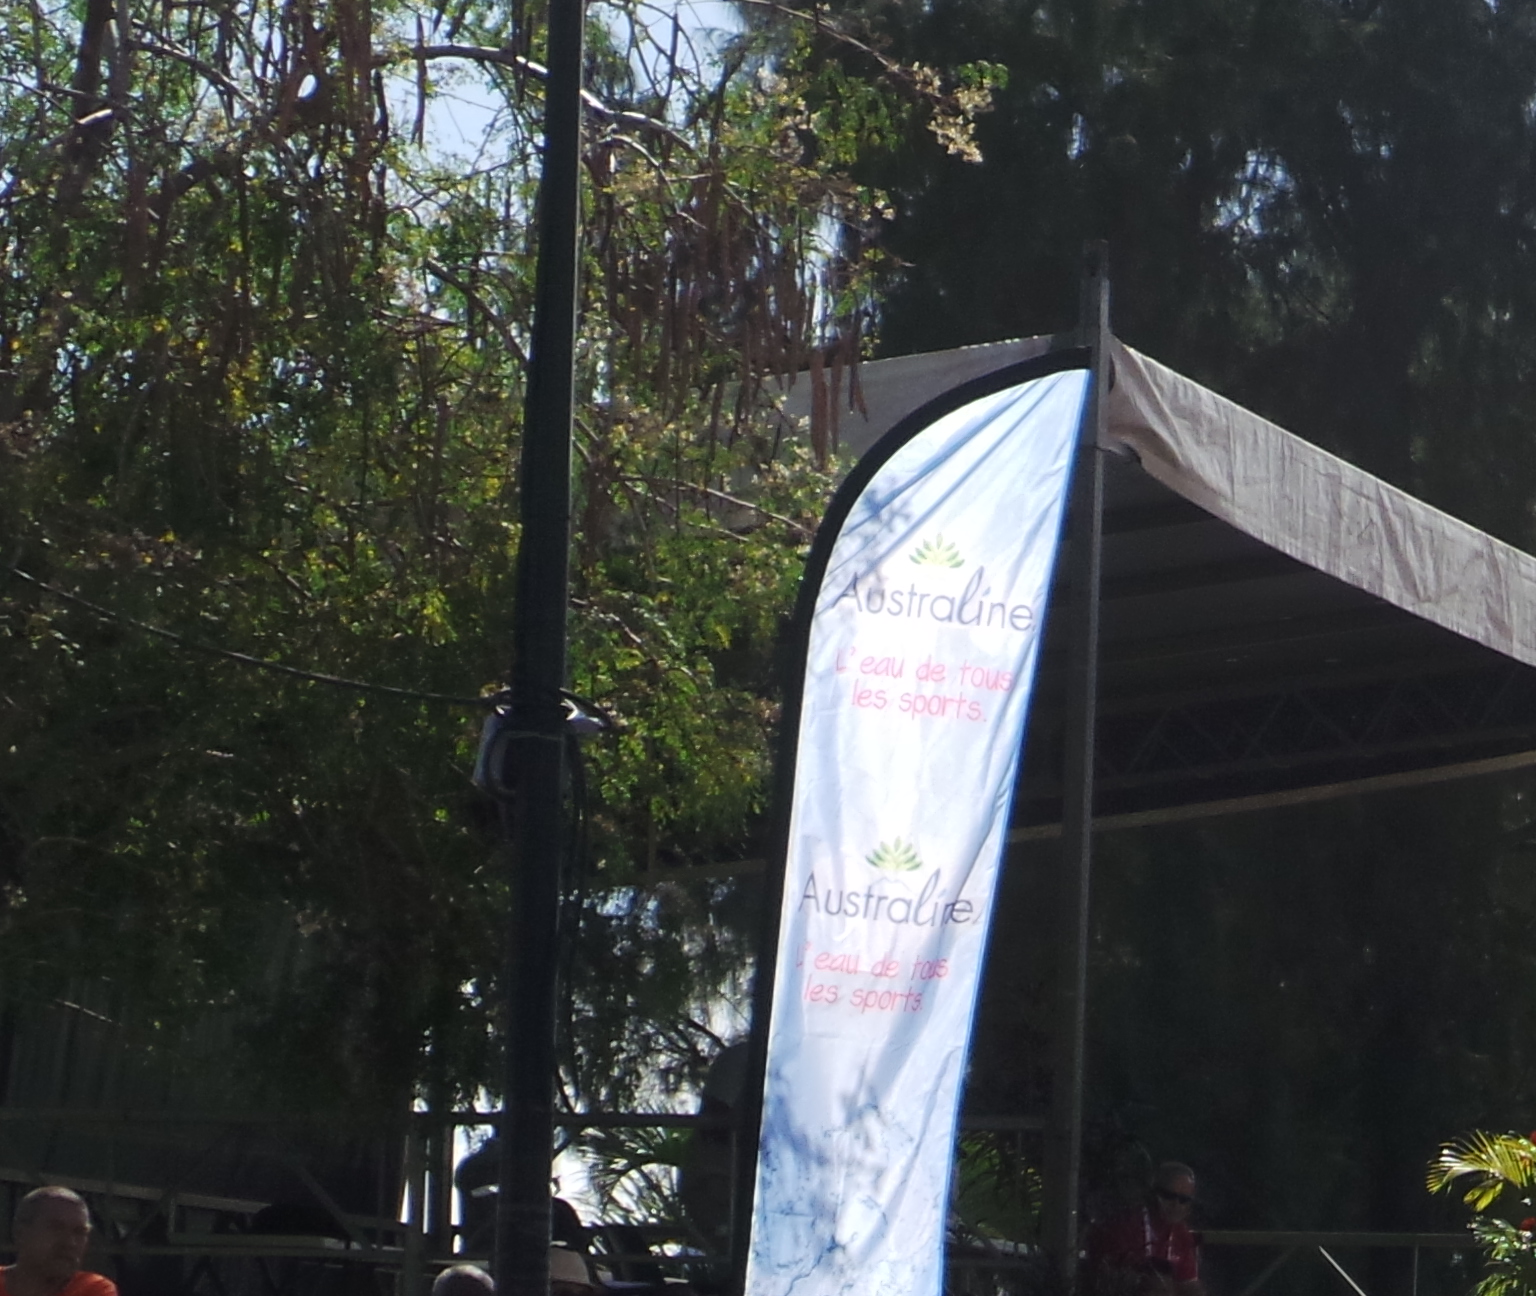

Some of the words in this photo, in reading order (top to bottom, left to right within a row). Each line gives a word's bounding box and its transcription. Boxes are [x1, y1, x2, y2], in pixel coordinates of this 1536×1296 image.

[834, 565, 1036, 632] Australine
[915, 654, 946, 682] de
[960, 660, 1014, 692] tous
[852, 678, 888, 711] les
[898, 691, 988, 721] sports.
[871, 951, 900, 978] de
[804, 973, 840, 1005] les
